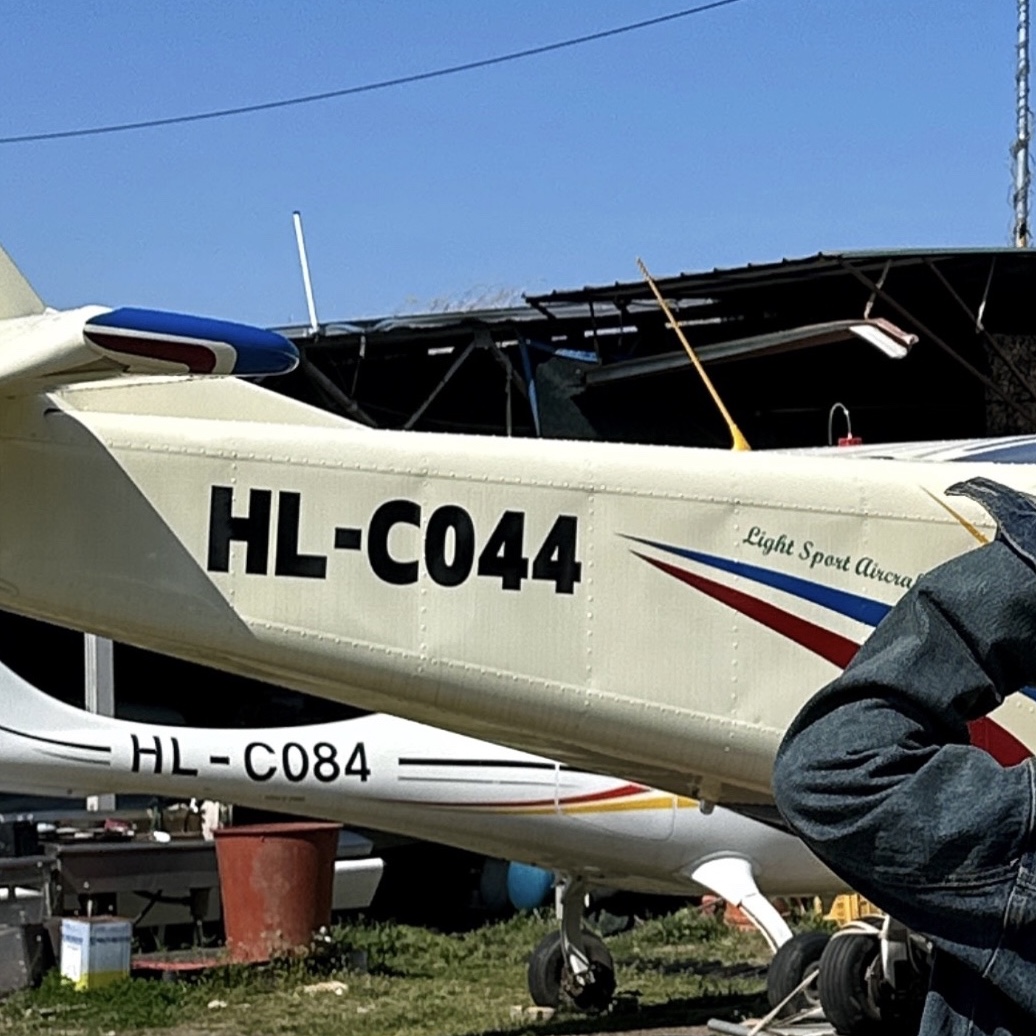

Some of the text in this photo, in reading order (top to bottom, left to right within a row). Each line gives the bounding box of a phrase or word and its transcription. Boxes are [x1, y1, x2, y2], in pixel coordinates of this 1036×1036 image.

[207, 485, 581, 594] HL-C044
[743, 526, 924, 589] Light Sport Aircra
